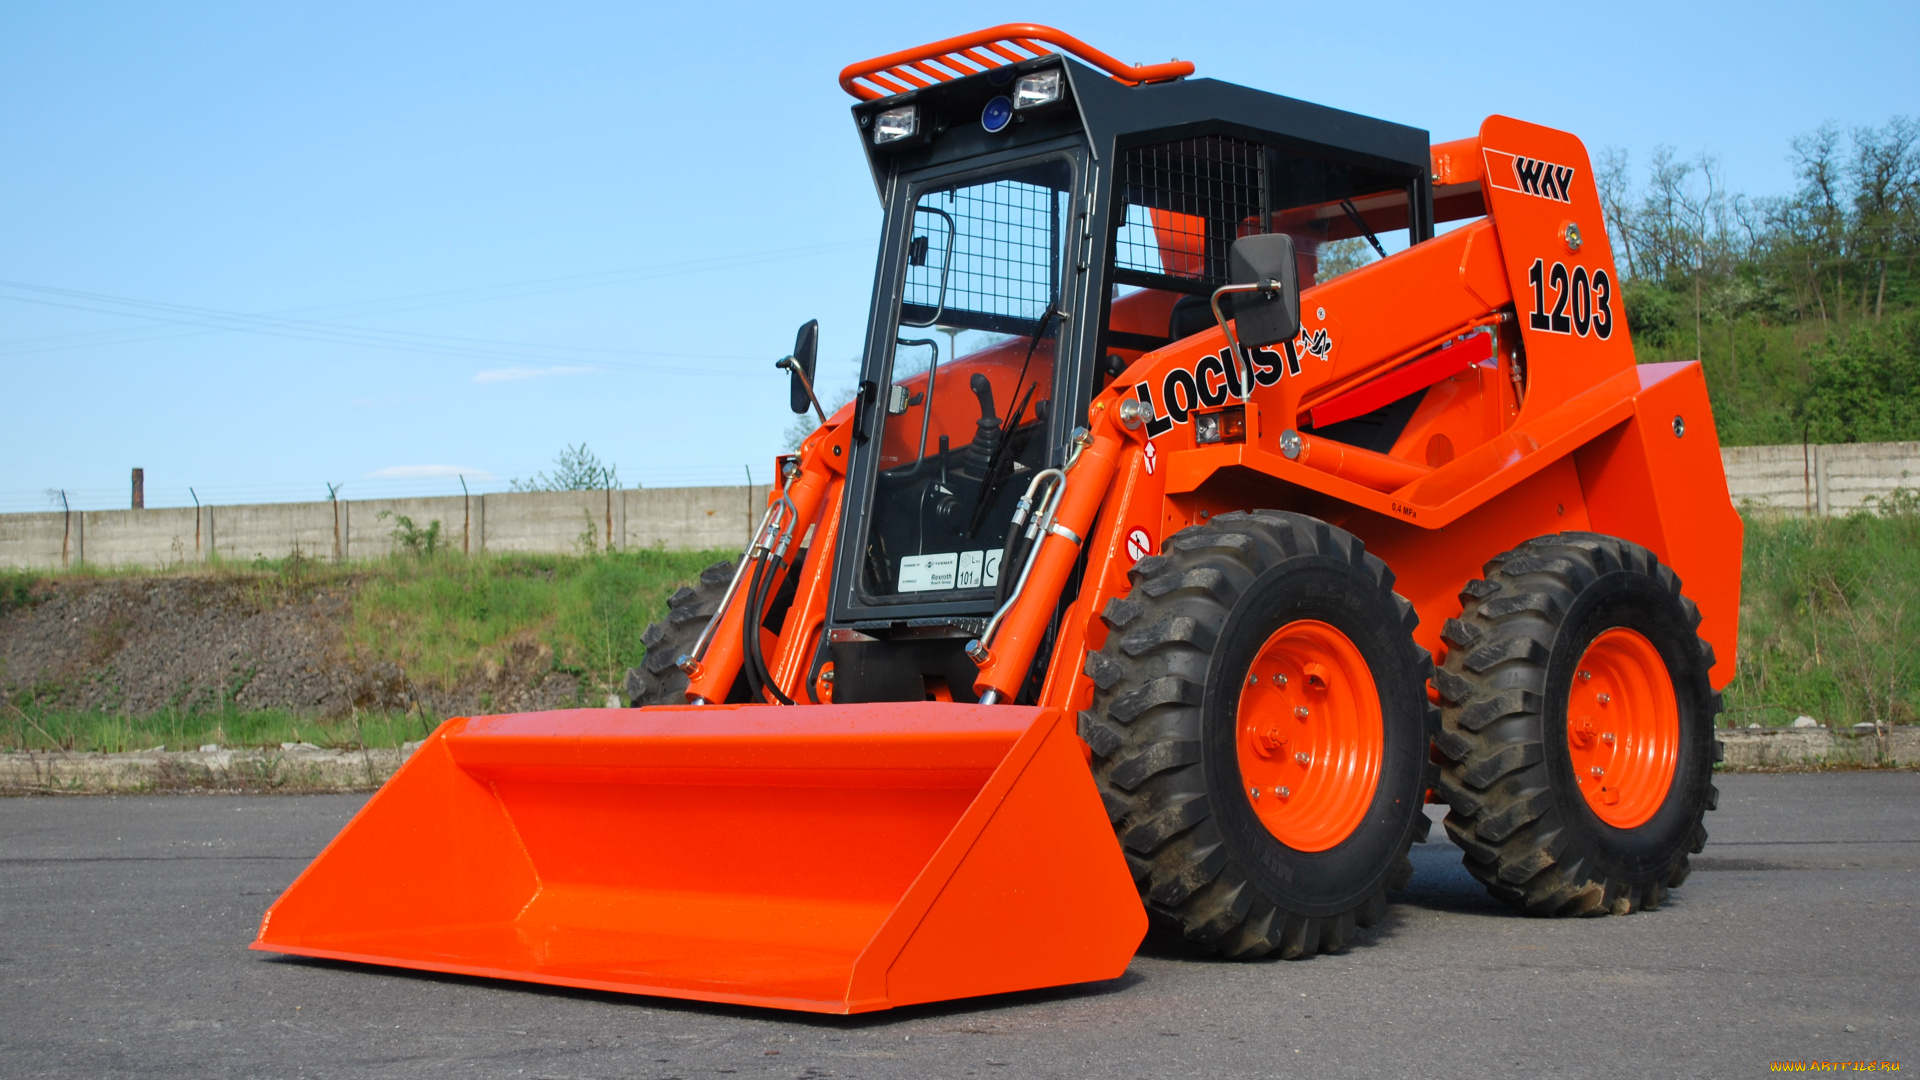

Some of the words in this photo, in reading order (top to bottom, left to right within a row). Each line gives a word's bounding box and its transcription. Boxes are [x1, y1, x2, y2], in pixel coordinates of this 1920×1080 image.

[1514, 155, 1575, 204] WAY
[1529, 258, 1612, 341] 1203
[1403, 506, 1417, 519] MPa
[931, 573, 952, 581] Rexroth
[960, 570, 973, 586] 101
